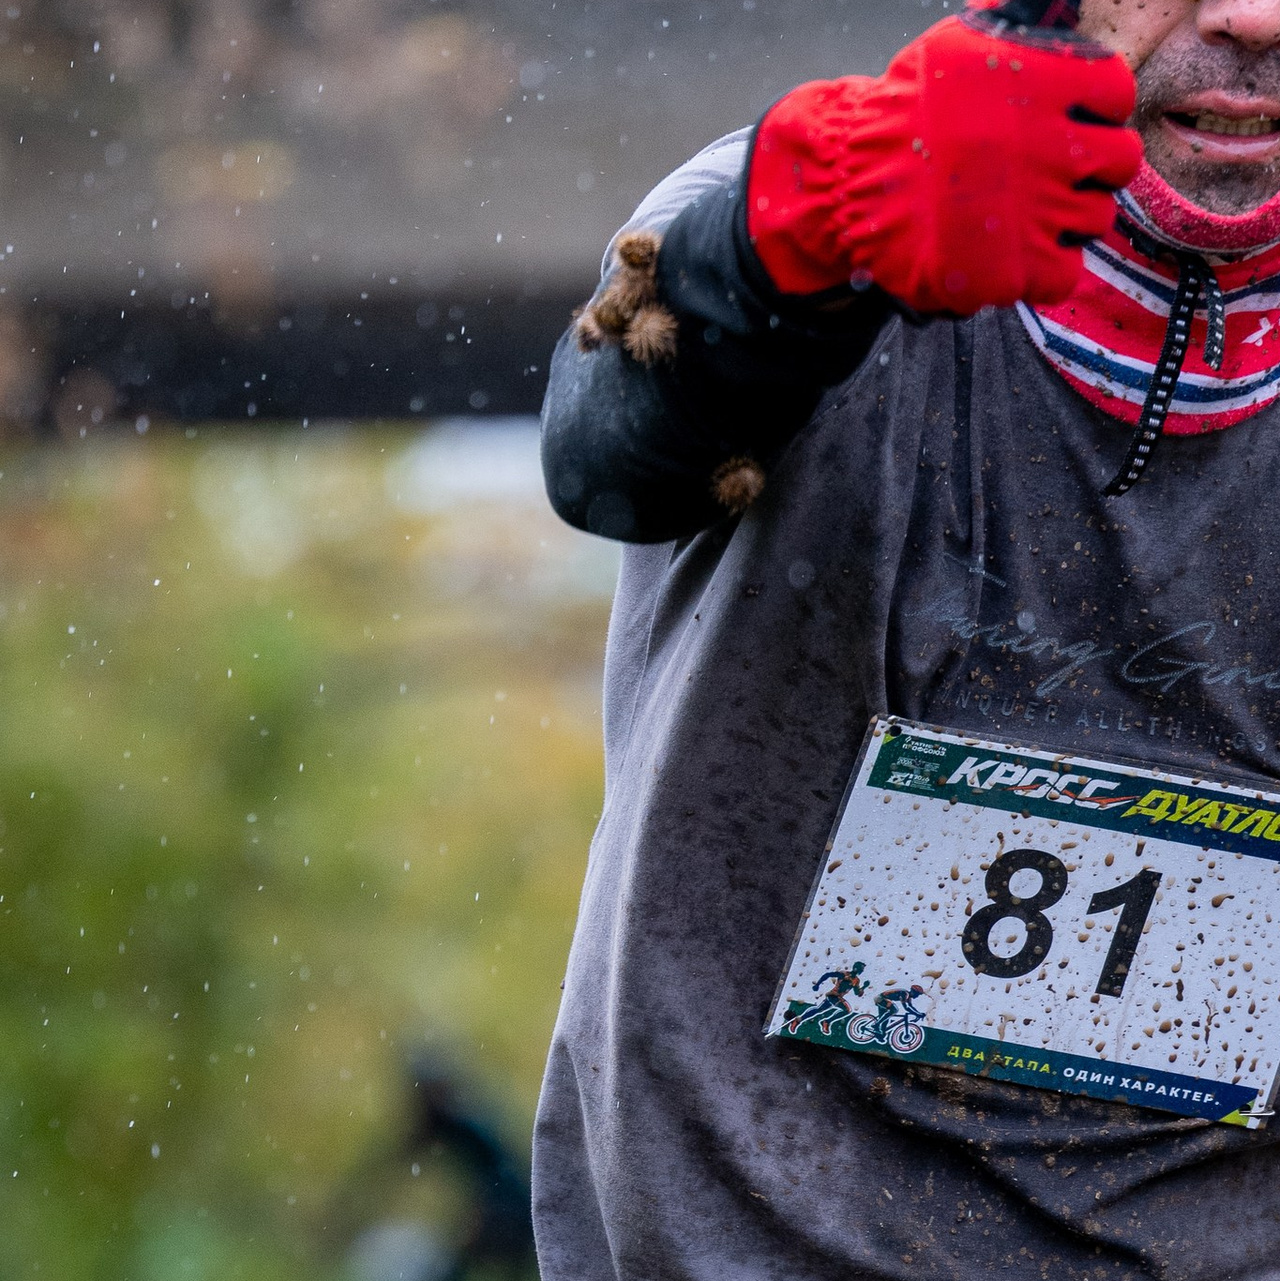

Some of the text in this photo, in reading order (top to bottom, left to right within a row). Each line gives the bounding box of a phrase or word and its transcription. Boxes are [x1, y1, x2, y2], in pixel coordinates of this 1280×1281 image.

[1076, 708, 1130, 732] ALL
[946, 756, 1138, 810] КРОСС
[960, 848, 1163, 998] 81
[947, 1045, 985, 1063] ДВА
[1063, 1066, 1115, 1086] ОДИН
[1120, 1076, 1222, 1107] ХАРАКТЕР.
